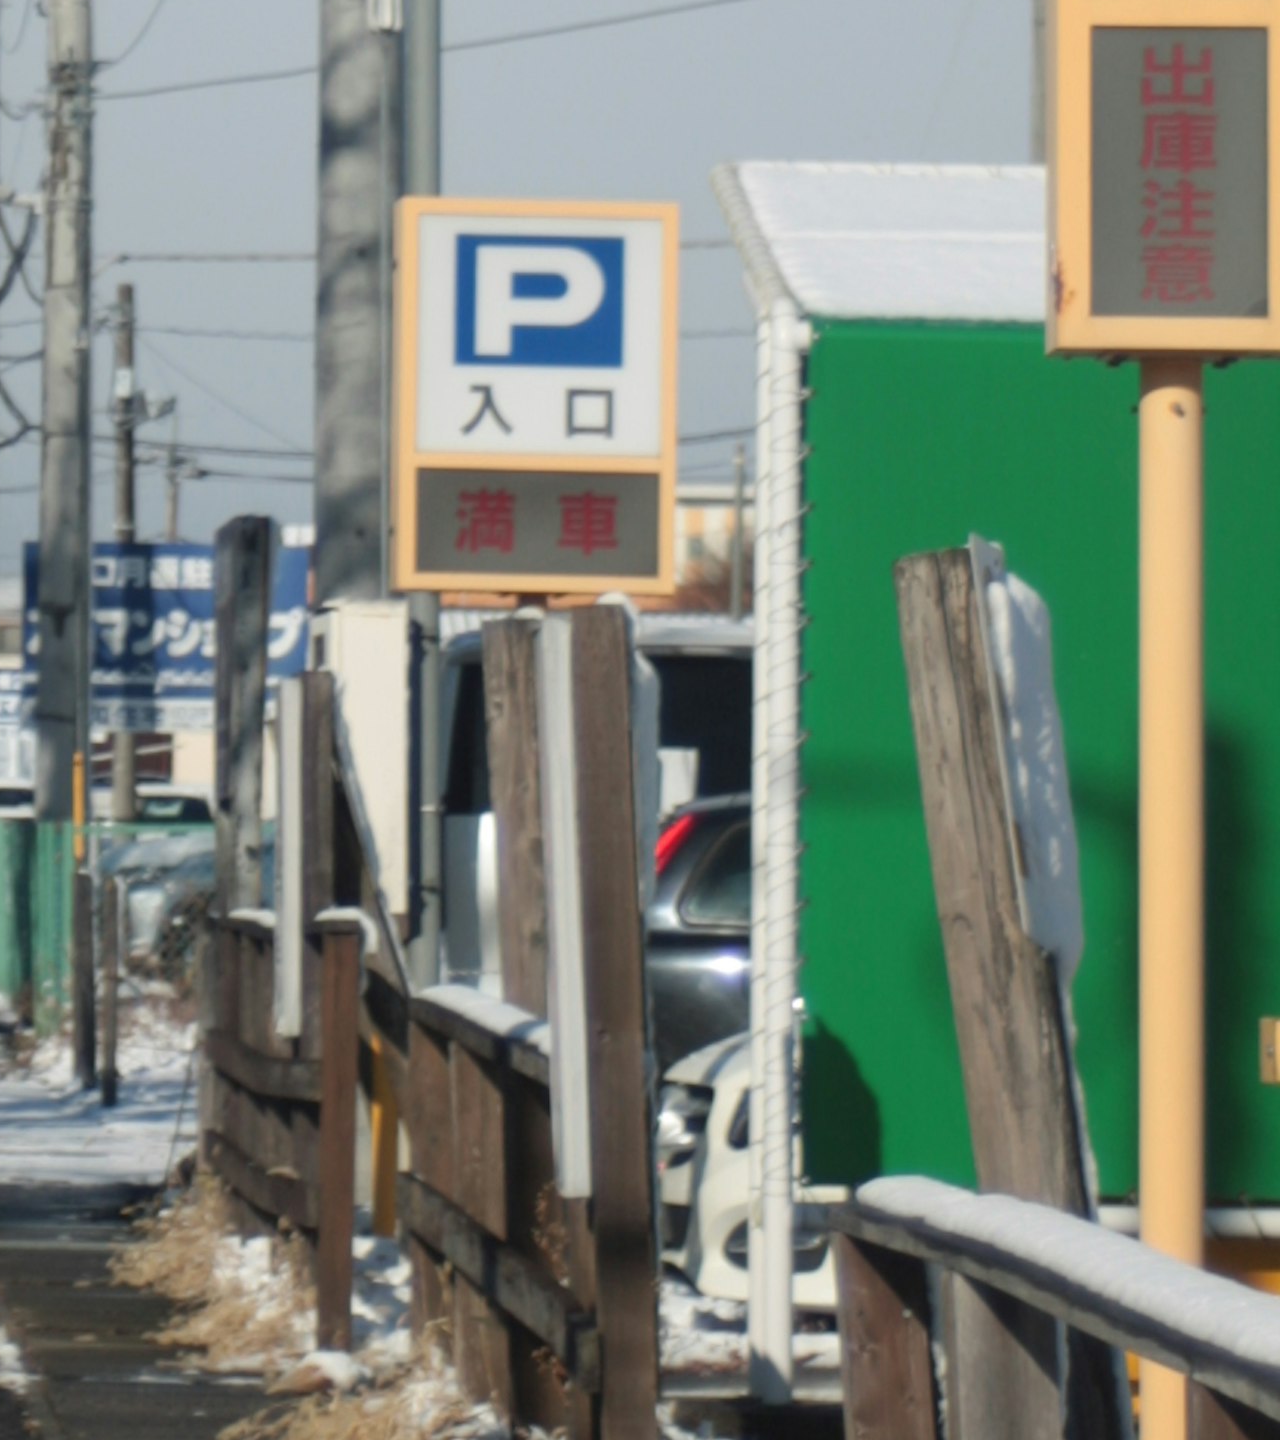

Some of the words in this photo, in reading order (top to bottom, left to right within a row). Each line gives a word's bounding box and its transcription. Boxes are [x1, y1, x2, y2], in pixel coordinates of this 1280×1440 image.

[1140, 42, 1218, 304] 出庫注意
[474, 245, 604, 356] P
[461, 384, 615, 439] 入口
[455, 488, 620, 557] 満車
